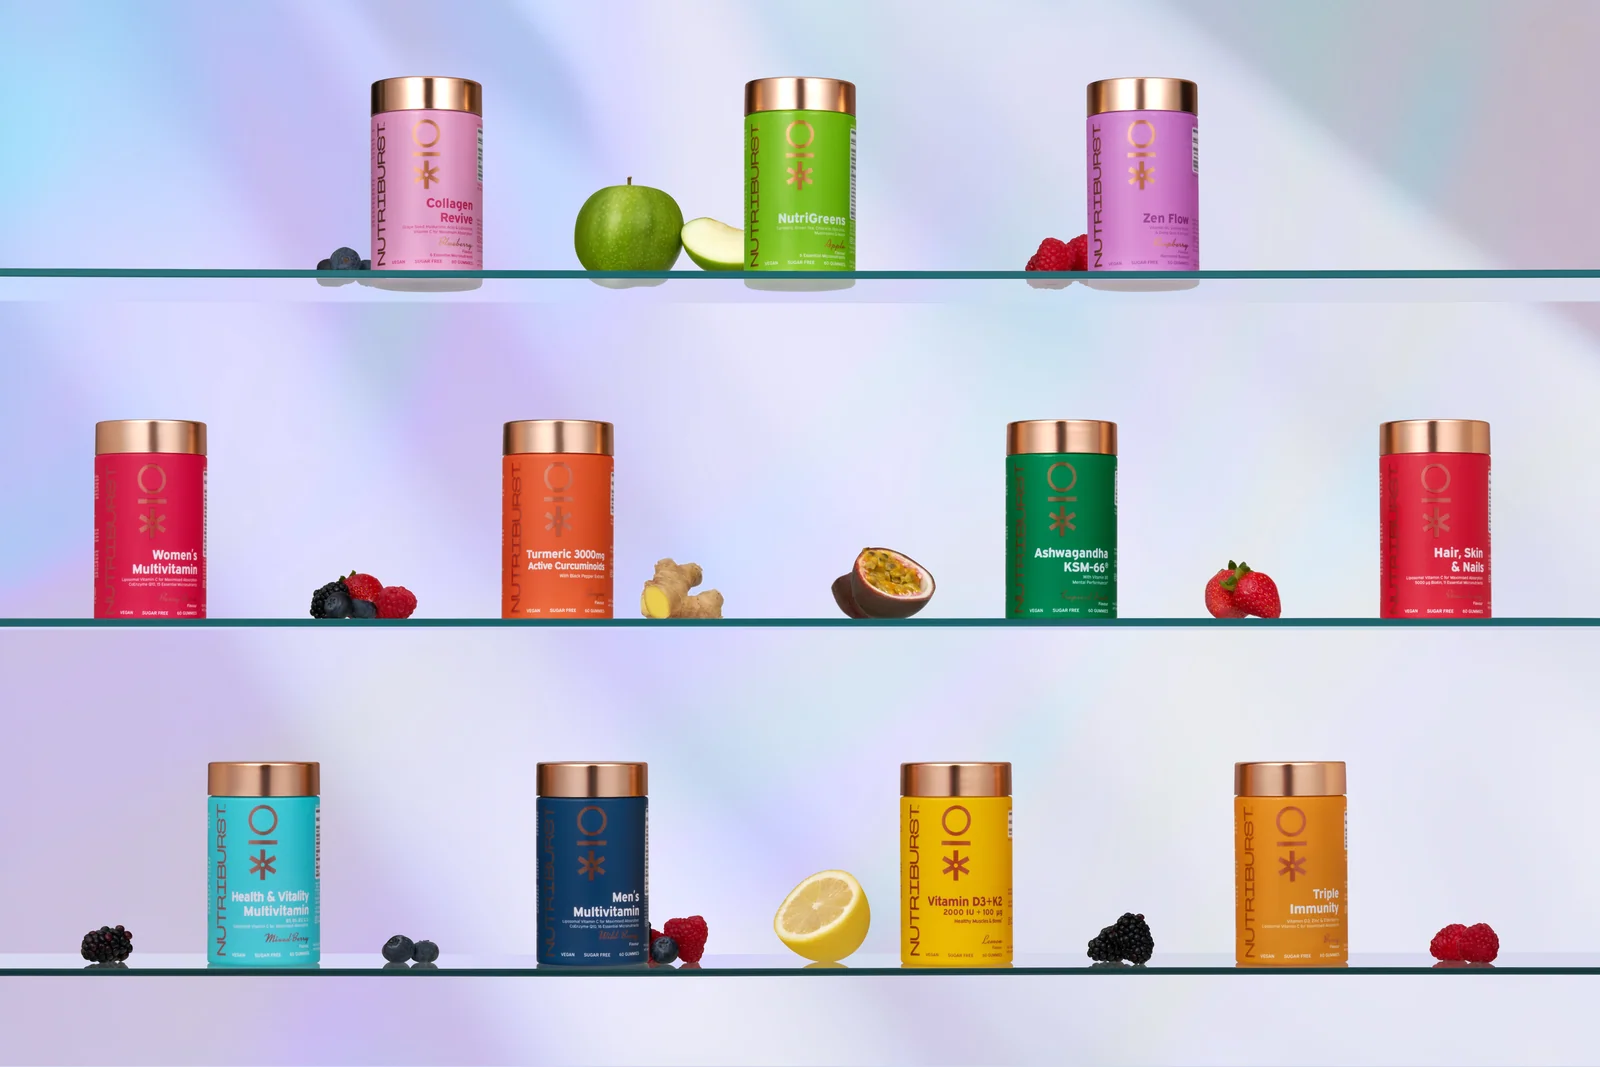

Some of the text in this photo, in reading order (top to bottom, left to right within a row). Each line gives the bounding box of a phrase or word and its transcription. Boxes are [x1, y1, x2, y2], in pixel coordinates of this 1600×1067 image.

[377, 122, 387, 266] NUTRIBURST
[750, 124, 760, 268] NUTRIBURST
[1093, 124, 1103, 268] NUTRIBURST
[426, 198, 473, 212] Collagen
[440, 212, 473, 224] Revive
[778, 212, 846, 226] NutriGreens
[1142, 212, 1189, 224] Zen Flow
[152, 548, 198, 561] Women's
[526, 548, 605, 562] Turmeric 3000mg
[1034, 547, 1108, 560] Ashwagandha
[1434, 546, 1484, 560] Hair, Skin
[132, 563, 198, 575] Multivitamin
[527, 561, 605, 571] Active Curcuminoids
[1451, 560, 1484, 573] & Nails
[216, 804, 227, 956] NUTRIBURST
[910, 804, 920, 957] NUTRIBURST
[1244, 807, 1256, 958] NUTRIBURST
[232, 890, 310, 904] Health & Vitality
[612, 890, 640, 903] Men's
[1312, 888, 1340, 901] Triple
[928, 896, 1003, 907] Vitamin D3+K2
[243, 904, 309, 917] Multivitamin
[573, 905, 640, 918] Multivitamin
[1290, 902, 1340, 916] Immunity
[982, 934, 1003, 945] Lemon
